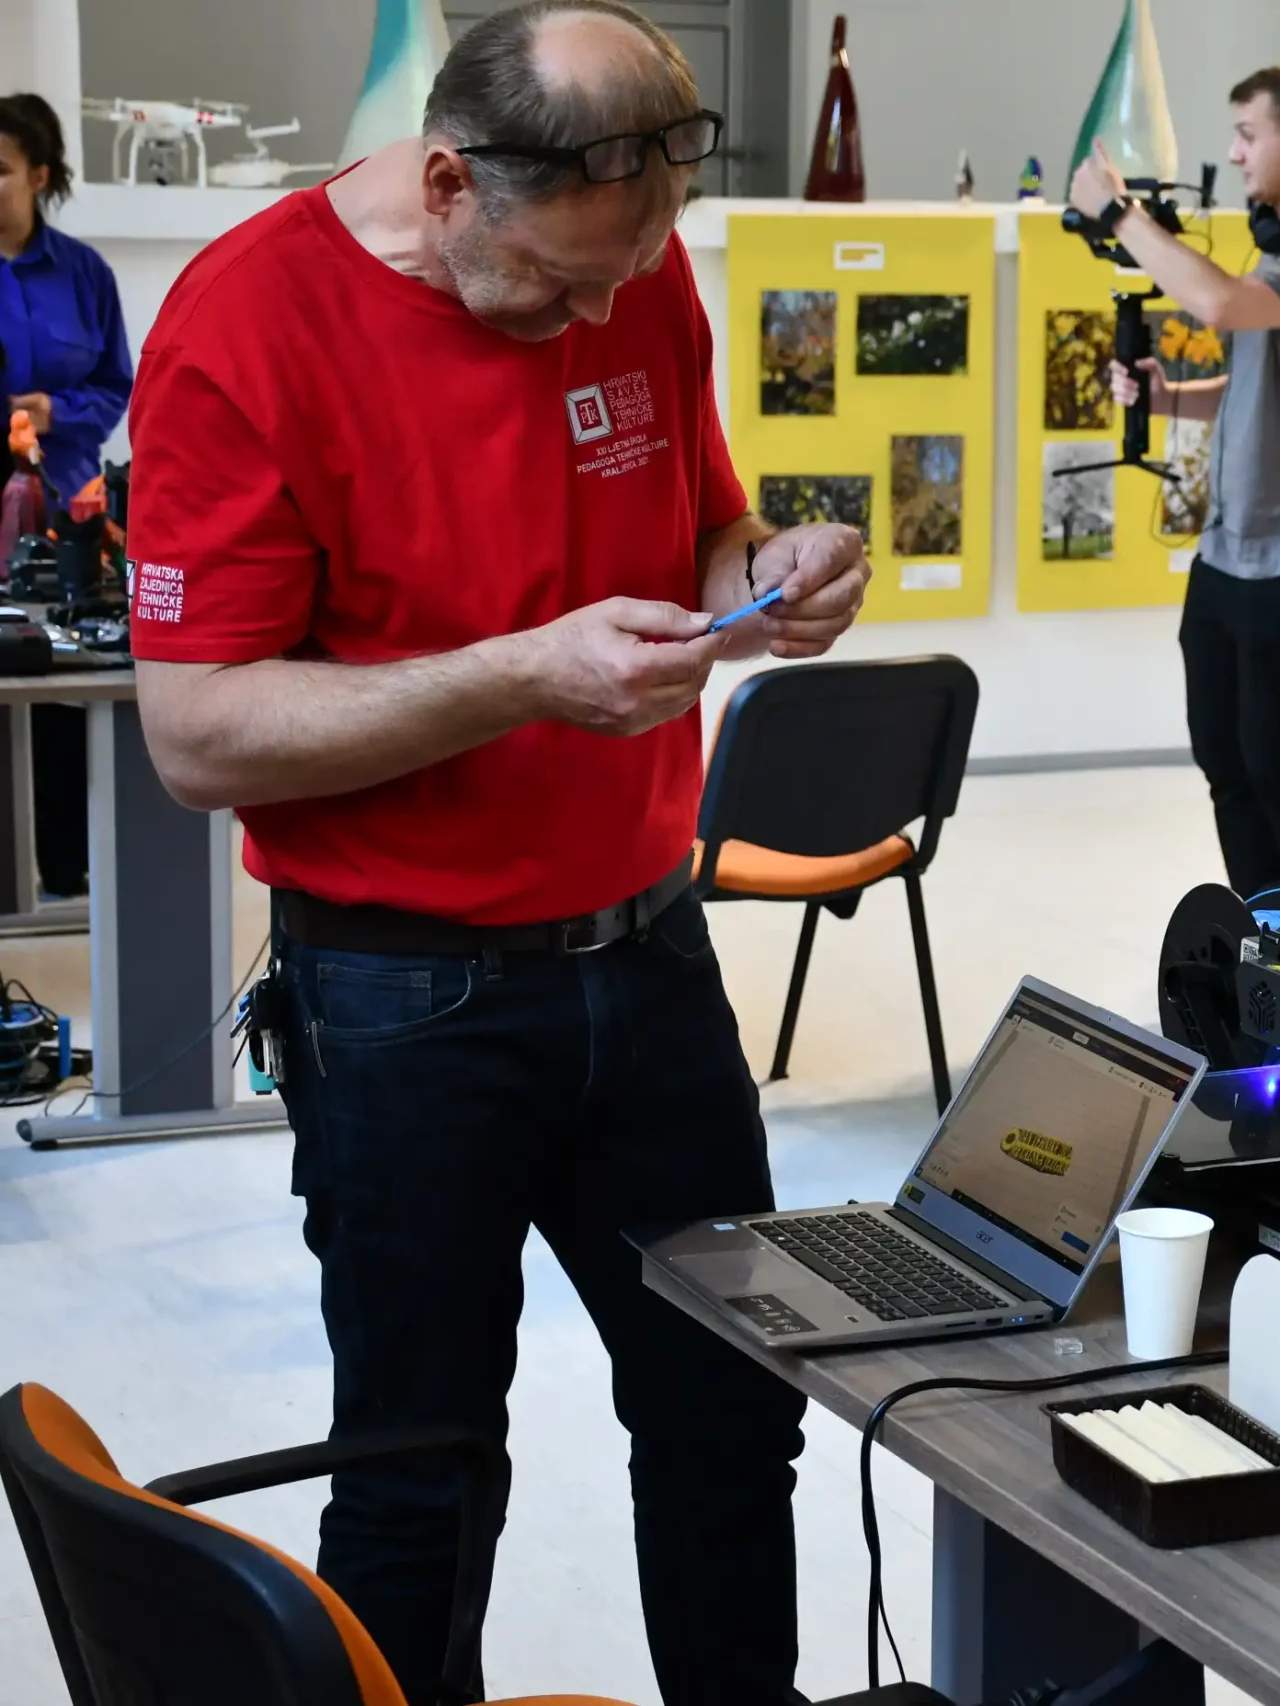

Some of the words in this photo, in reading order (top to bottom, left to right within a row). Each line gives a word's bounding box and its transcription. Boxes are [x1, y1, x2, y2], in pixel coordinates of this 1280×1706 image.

[603, 369, 648, 391] HRVATSKI
[609, 391, 652, 411] PEDAGOGA
[616, 411, 656, 432] KULTURE
[576, 456, 617, 475] PEDAGOGA
[141, 562, 185, 582] HRVATSKA
[140, 576, 184, 596] ZAJEDNICA
[137, 605, 182, 623] KULTURE
[975, 1230, 995, 1244] acer
